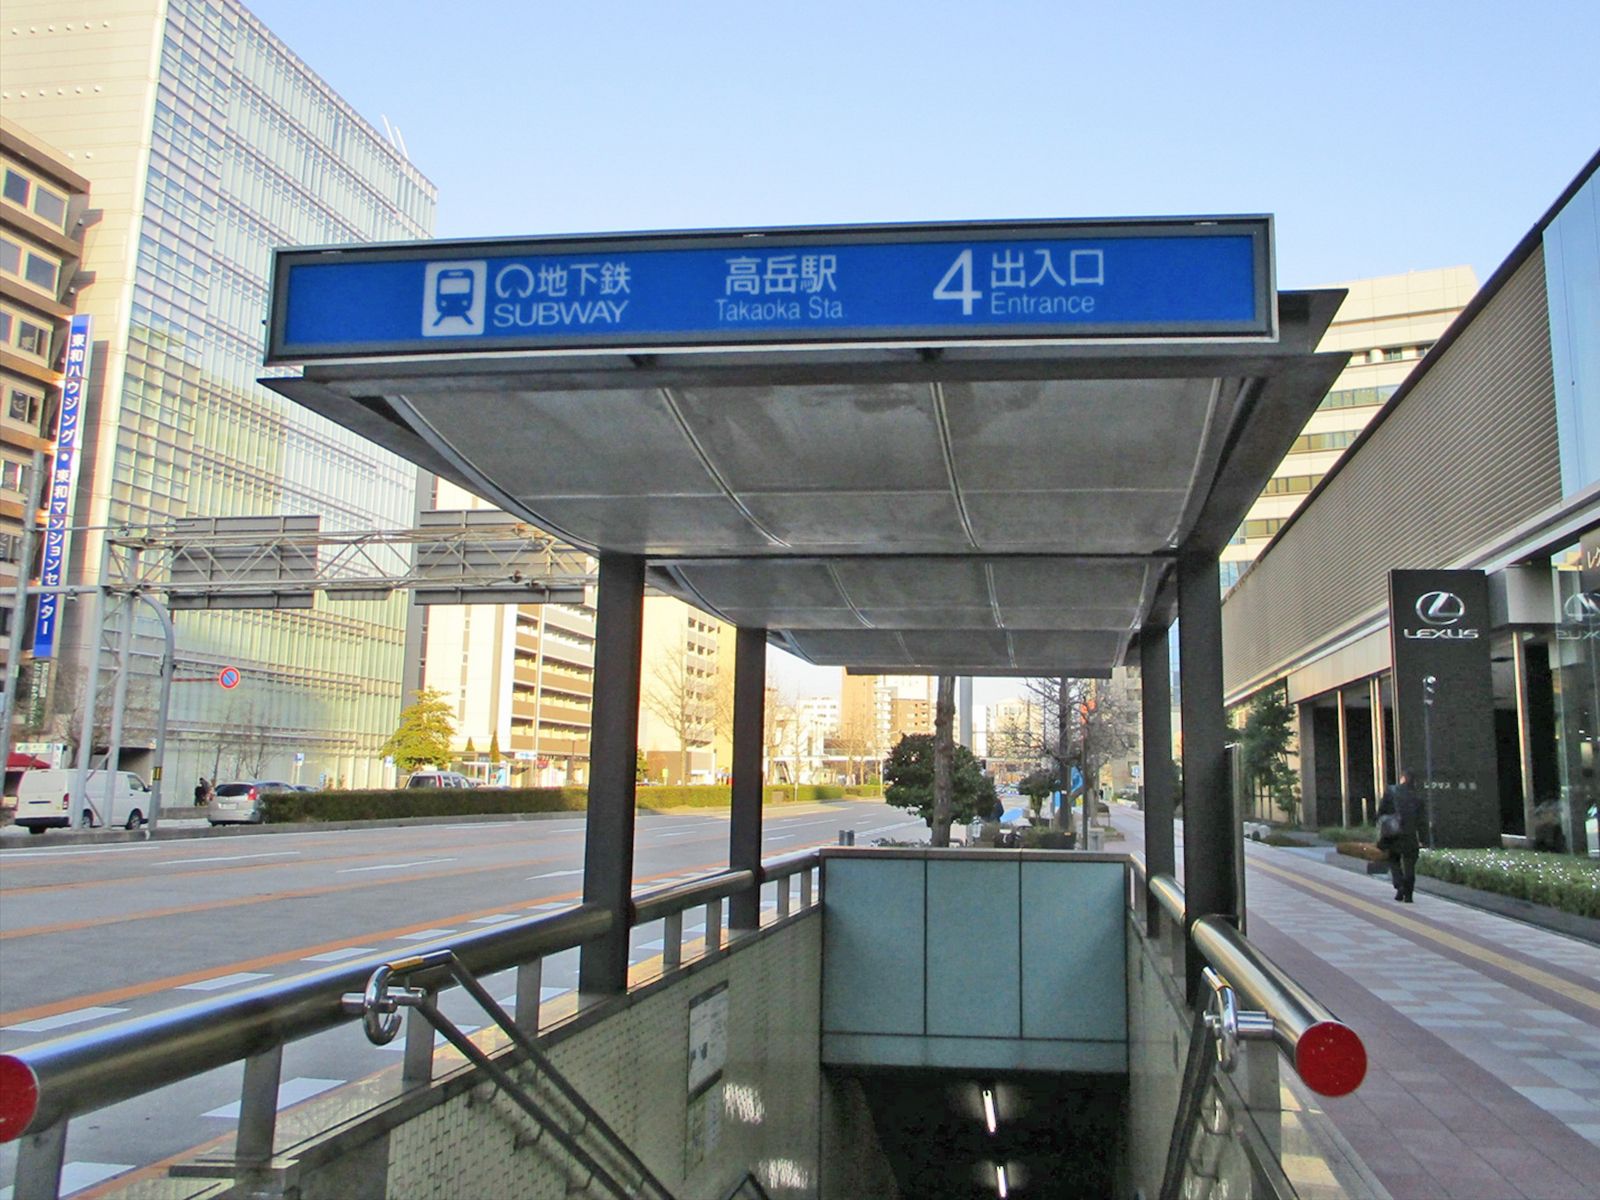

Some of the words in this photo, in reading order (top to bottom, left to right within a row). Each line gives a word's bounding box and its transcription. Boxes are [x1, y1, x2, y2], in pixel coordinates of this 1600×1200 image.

[537, 263, 632, 297] 地下鉄
[725, 254, 837, 295] 高岳駅
[933, 248, 983, 316] 4
[990, 249, 1105, 289] 出入口
[493, 300, 629, 328] SUBWAY
[715, 298, 800, 322] Takaoka
[808, 295, 843, 320] Sta
[990, 291, 1096, 316] Entrance
[1403, 628, 1480, 640] LEXUS
